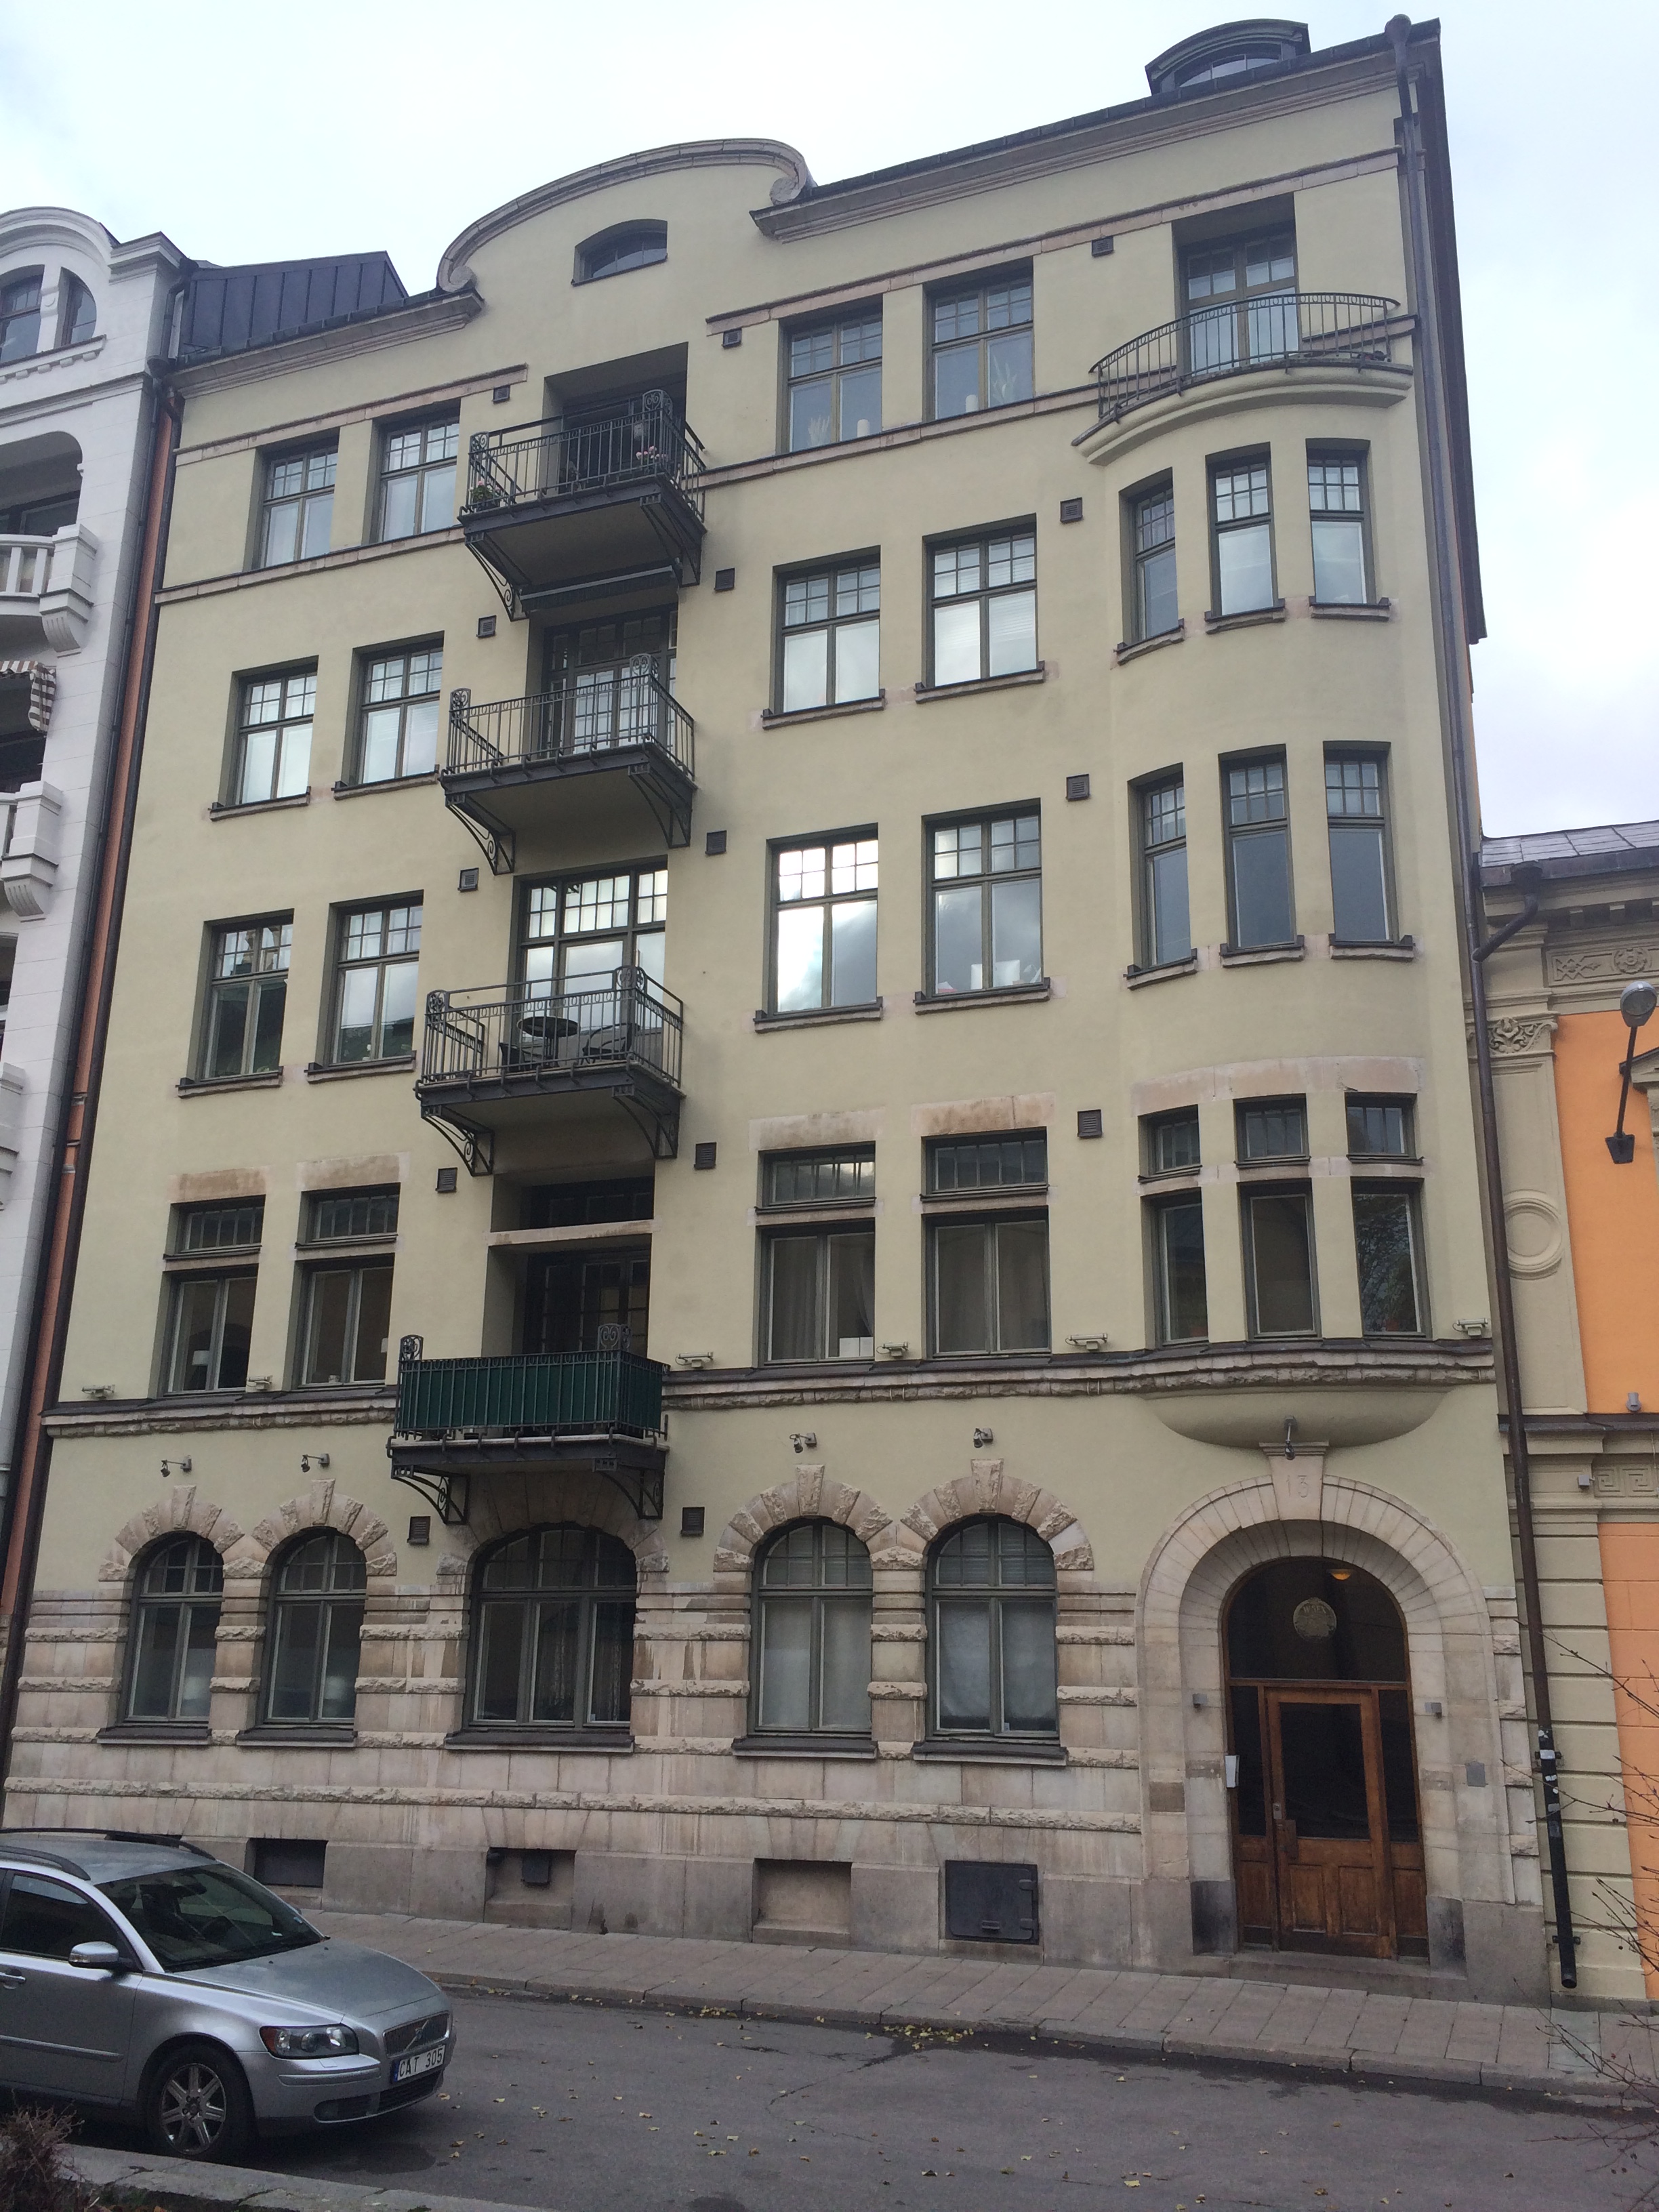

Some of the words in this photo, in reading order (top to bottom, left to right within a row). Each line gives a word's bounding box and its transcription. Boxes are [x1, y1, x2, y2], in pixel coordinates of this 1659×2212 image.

[1286, 1475, 1309, 1498] 13
[399, 2056, 420, 2077] CAT
[426, 2047, 443, 2068] 305
